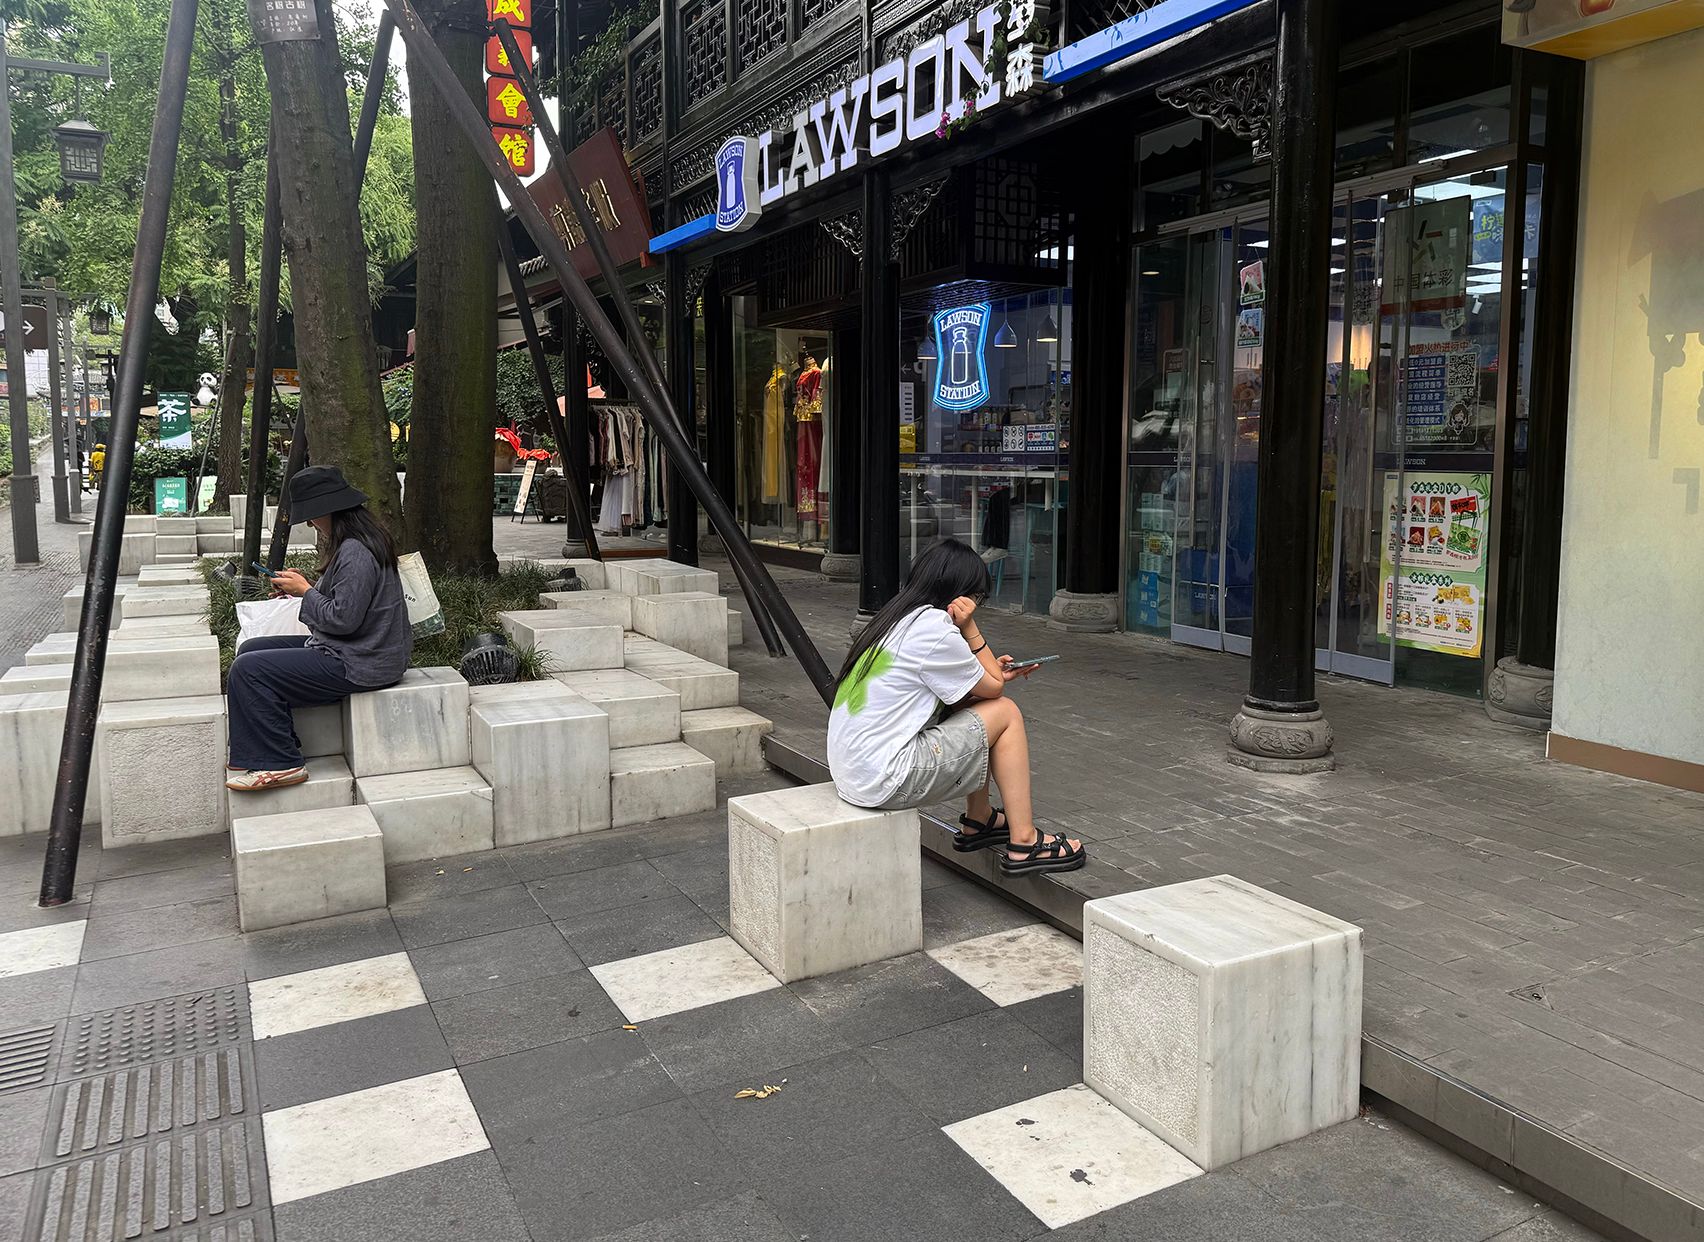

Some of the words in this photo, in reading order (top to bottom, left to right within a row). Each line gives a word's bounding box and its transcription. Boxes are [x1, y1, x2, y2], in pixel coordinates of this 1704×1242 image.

[759, 2, 1001, 207] LAWSON
[717, 144, 744, 168] LAWSON
[719, 203, 745, 224] STATION
[1394, 268, 1453, 292] 中国体彩
[940, 310, 982, 333] LAWSON
[940, 381, 980, 400] STATION
[158, 399, 187, 422] 茶
